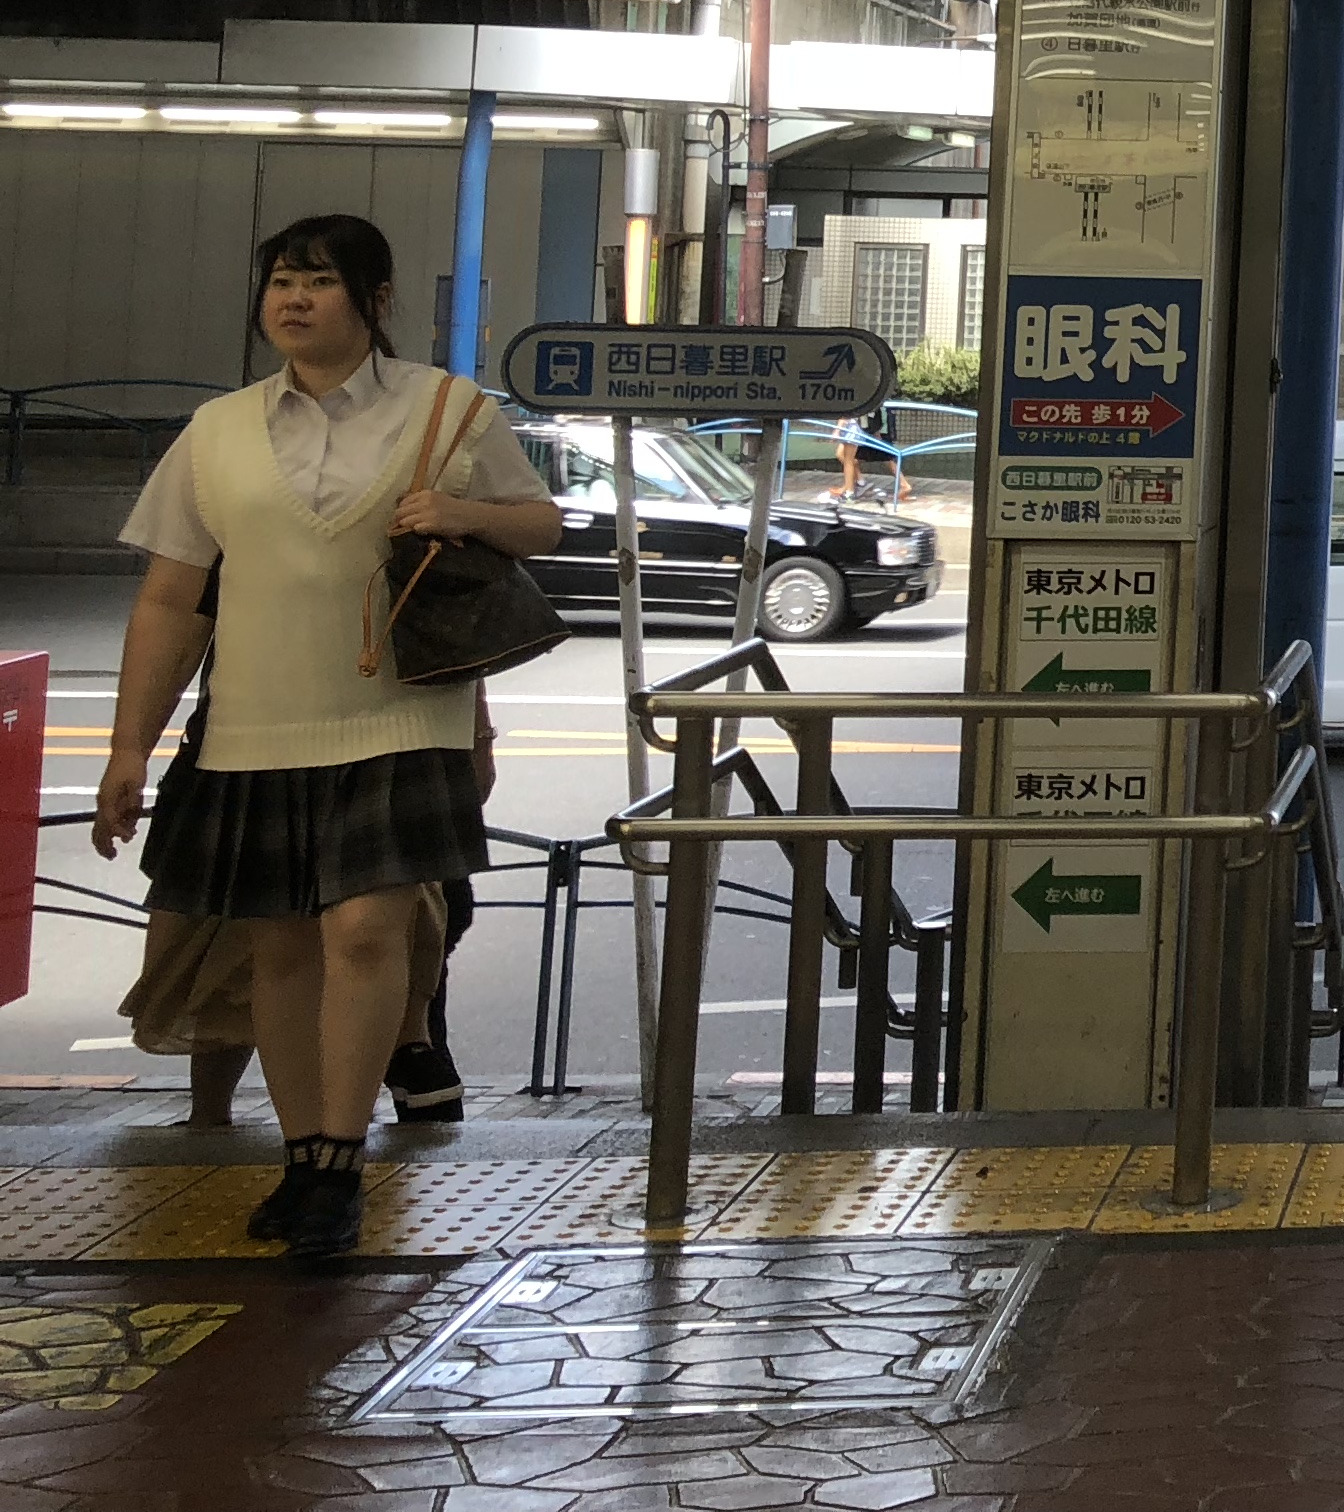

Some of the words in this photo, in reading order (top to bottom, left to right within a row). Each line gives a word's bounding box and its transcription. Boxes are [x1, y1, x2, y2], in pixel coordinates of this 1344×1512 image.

[1013, 303, 1187, 384] 眼科
[607, 342, 787, 376] 西日暮里駅
[746, 383, 782, 400] Sta.
[799, 383, 855, 402] 170m
[1022, 405, 1081, 423] この先
[1001, 500, 1100, 523] こさか眼科
[1024, 569, 1155, 596] 東京メトロ
[1023, 605, 1157, 635] 千代田線
[1015, 774, 1146, 801] 東京メトロ
